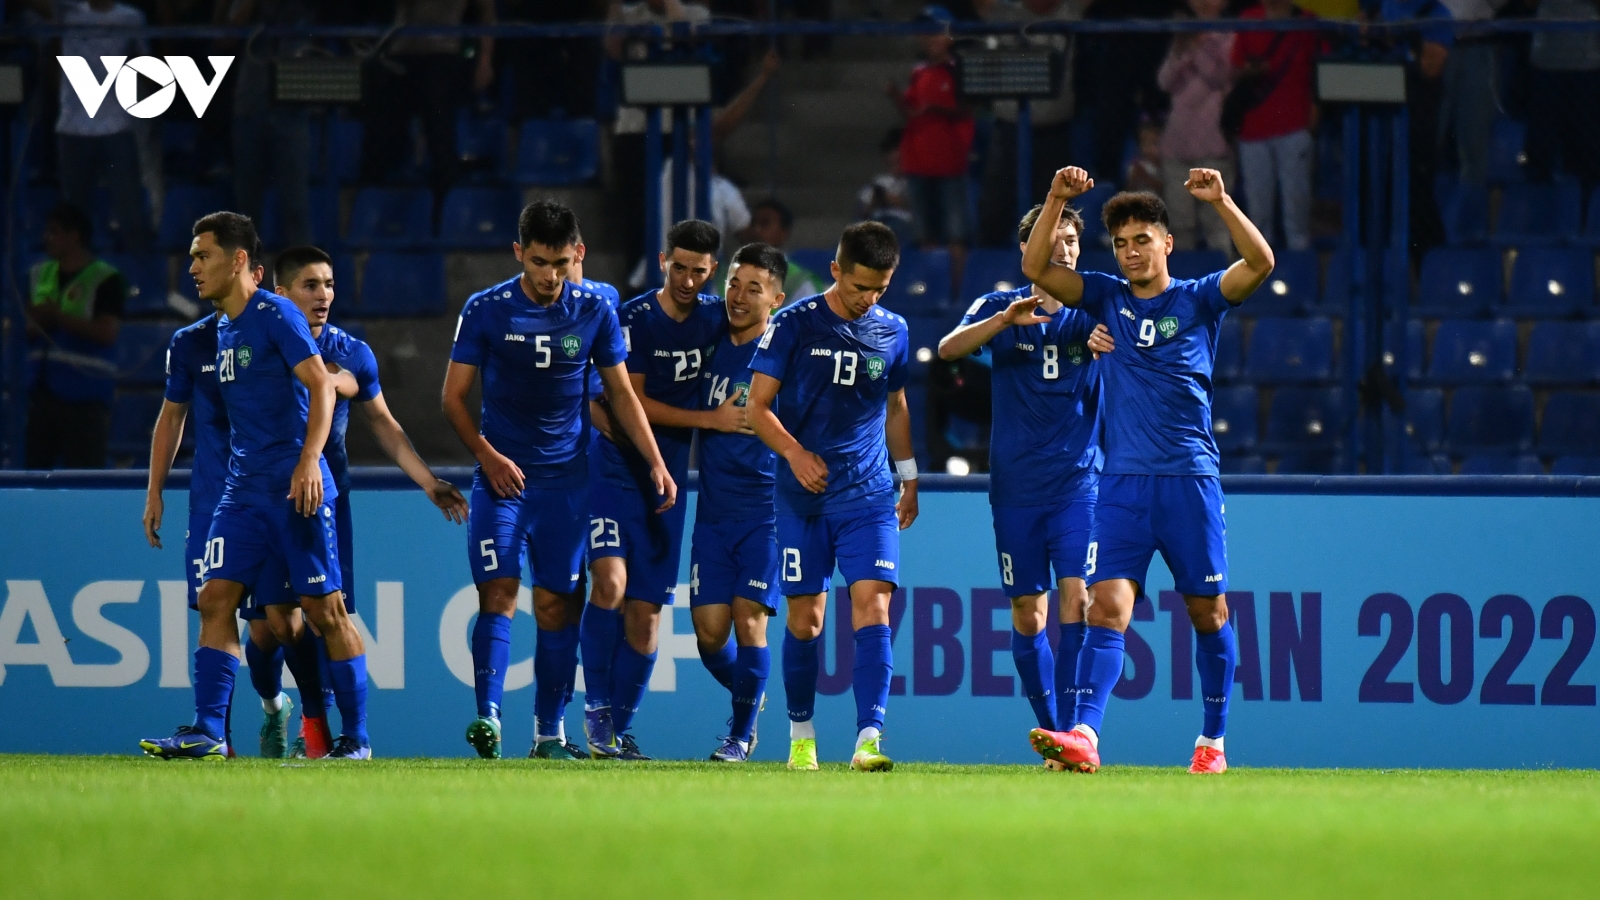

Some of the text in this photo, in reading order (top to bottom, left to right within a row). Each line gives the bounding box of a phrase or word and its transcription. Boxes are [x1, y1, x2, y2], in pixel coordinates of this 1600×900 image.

[504, 333, 526, 342] JAKO
[1136, 318, 1156, 347] 9
[1160, 319, 1177, 332] UFA
[238, 350, 250, 360] UFA
[535, 335, 552, 368] 5
[563, 339, 579, 349] UFA
[810, 348, 832, 357] JAKO
[201, 364, 216, 373] JAK
[220, 348, 235, 383] 20
[672, 348, 702, 382] 23
[832, 350, 858, 386] 13
[868, 360, 882, 371] UFA
[1043, 344, 1059, 380] 8
[707, 374, 730, 406] 14
[590, 518, 621, 549] 23
[480, 538, 499, 572] 5
[782, 547, 802, 582] 13
[875, 559, 895, 569] JAKO
[1001, 552, 1014, 586] 8
[1086, 541, 1098, 576] 9
[307, 574, 327, 584] JAKO
[690, 563, 700, 595] 4
[748, 578, 768, 590] JAKO
[1204, 573, 1223, 583] JAKO
[0, 580, 405, 689] ASIN
[1357, 592, 1597, 706] 2022
[1205, 696, 1227, 704] JAKO
